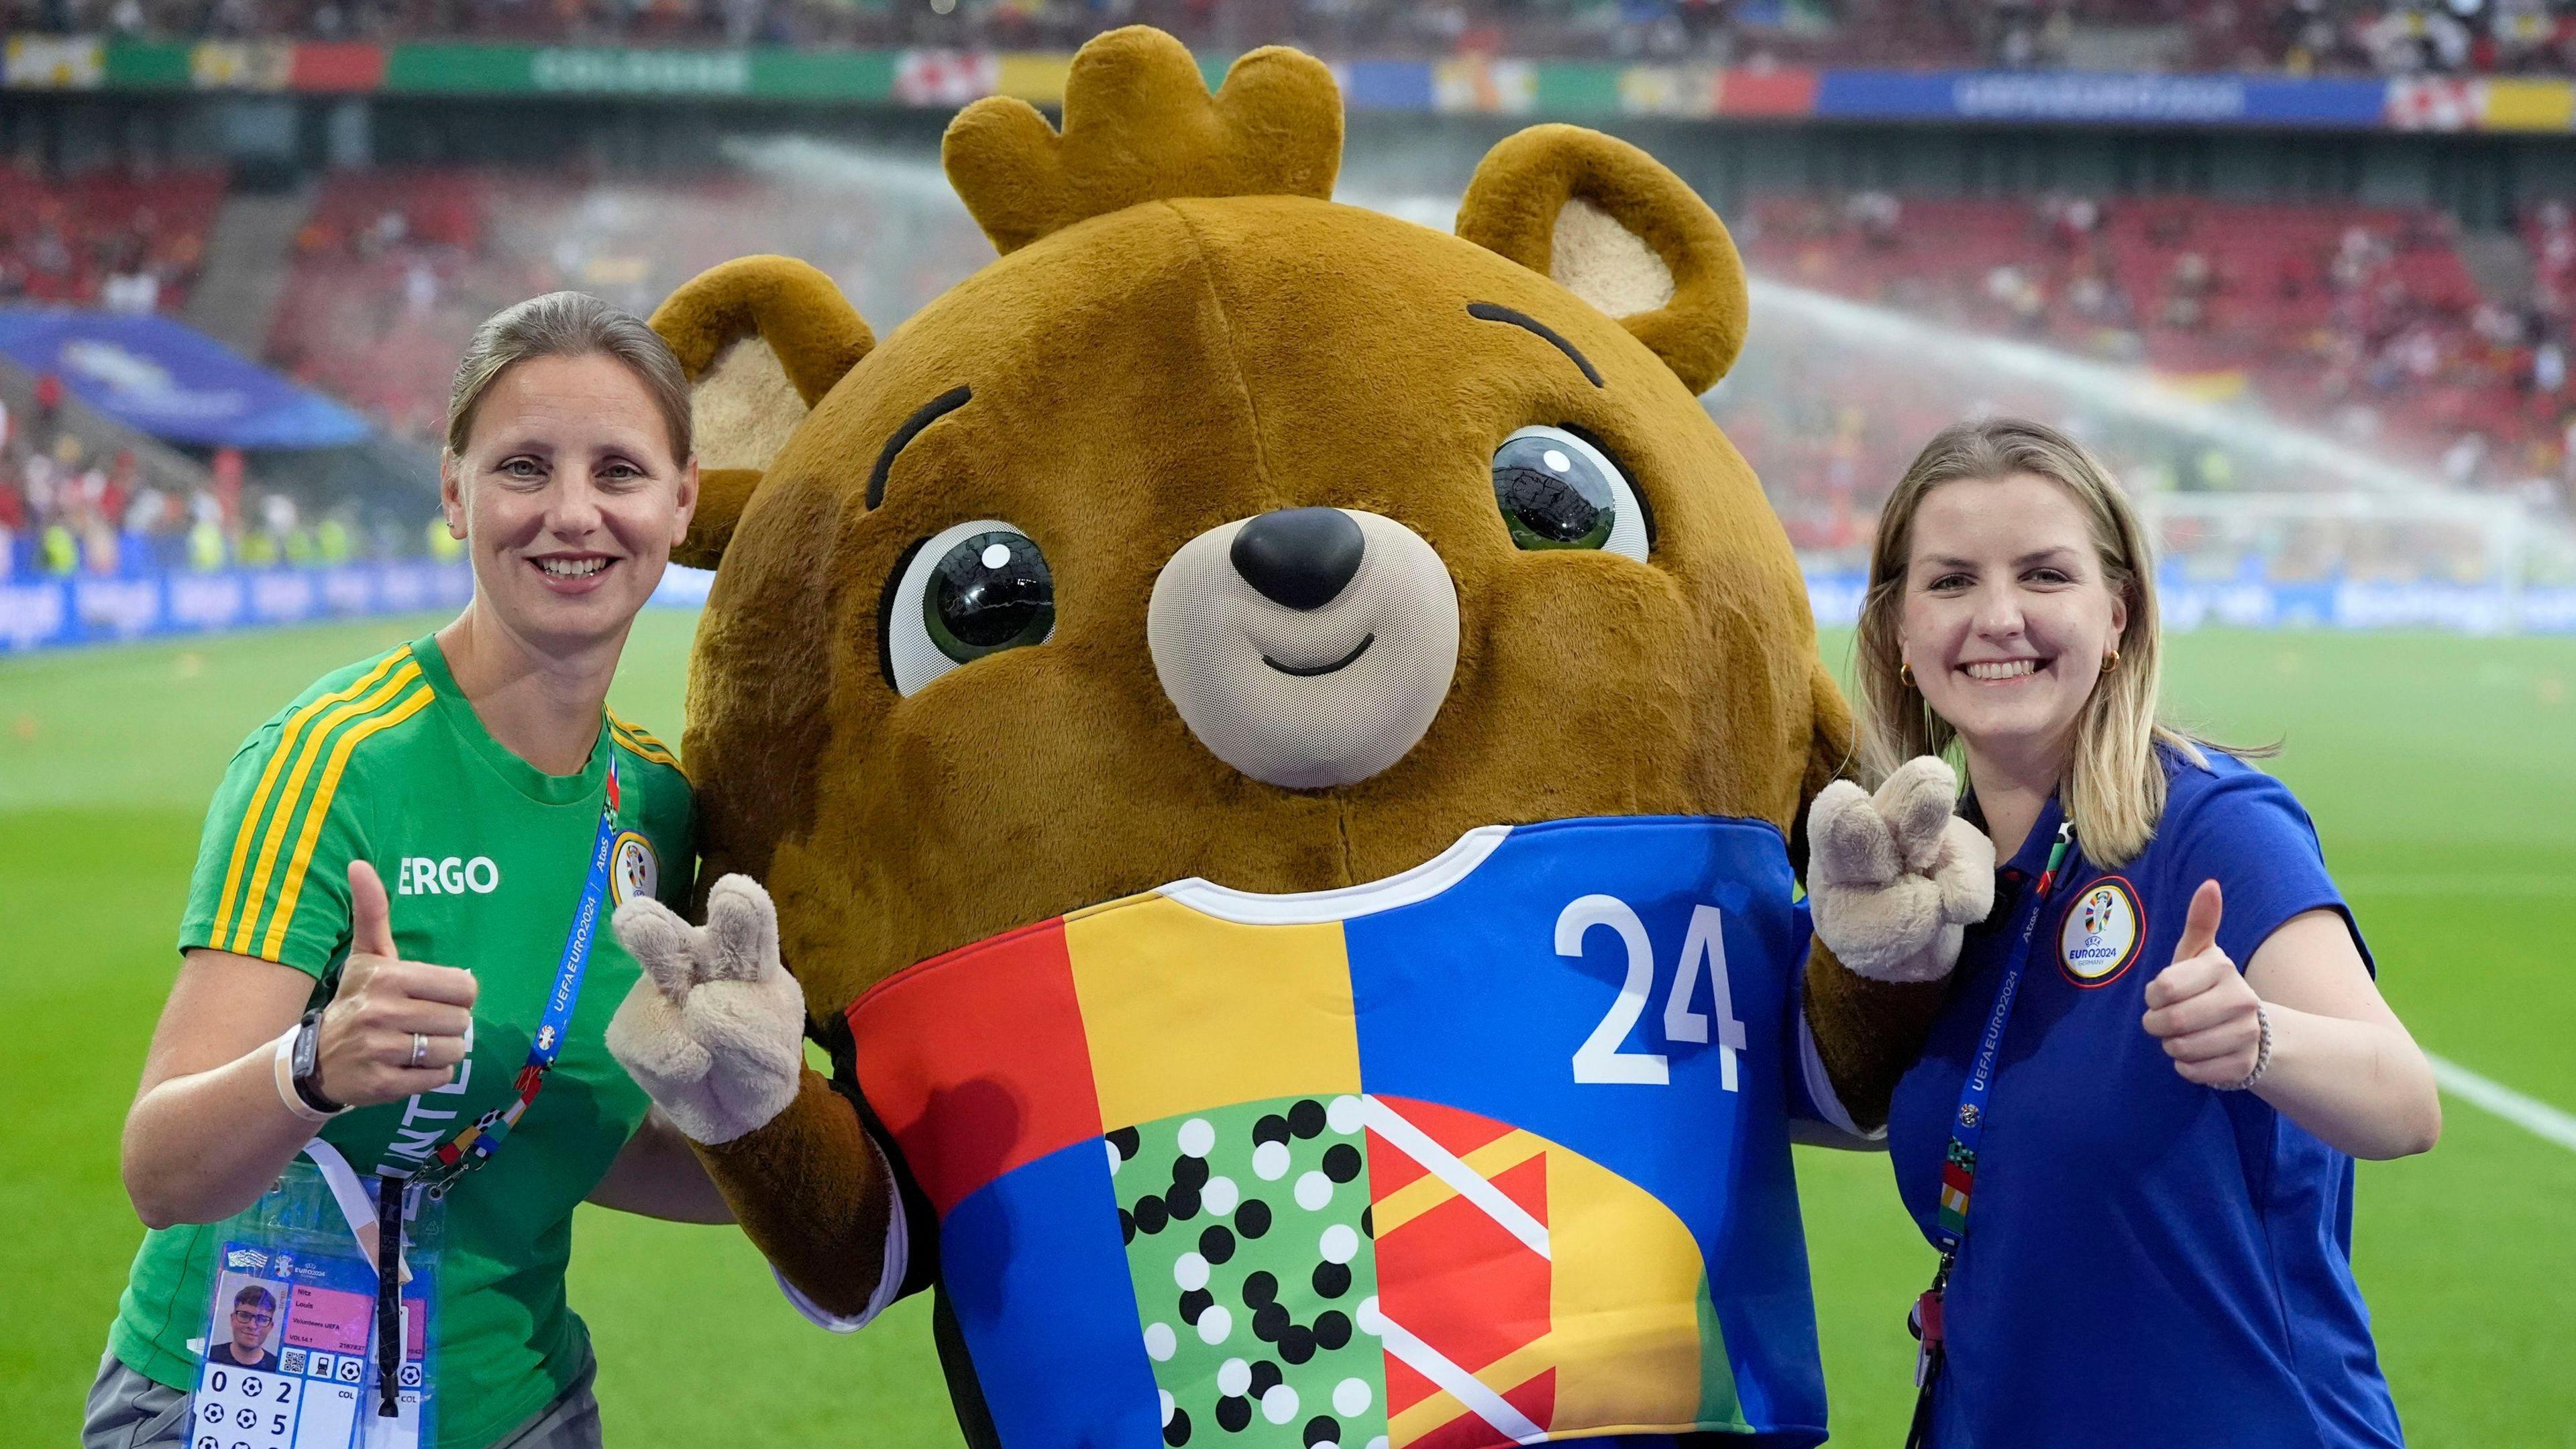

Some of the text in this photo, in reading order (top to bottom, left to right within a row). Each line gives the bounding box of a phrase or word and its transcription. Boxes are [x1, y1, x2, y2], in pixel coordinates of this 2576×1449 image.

[596, 837, 609, 873] Atos
[398, 856, 498, 894] ERGO
[2023, 907, 2039, 943] Atos
[554, 896, 596, 1012] UEFAEURO2024
[2070, 948, 2116, 959] EURO2024
[2084, 937, 2101, 947] UEFA
[1554, 894, 1747, 1092] 24
[1972, 971, 2017, 1091] UEFAEURO2024
[295, 1301, 313, 1309] Louis
[293, 1318, 323, 1328] Volunteers
[211, 1371, 291, 1403] 0 2
[338, 1391, 354, 1399] COL
[271, 1414, 287, 1435] 5
